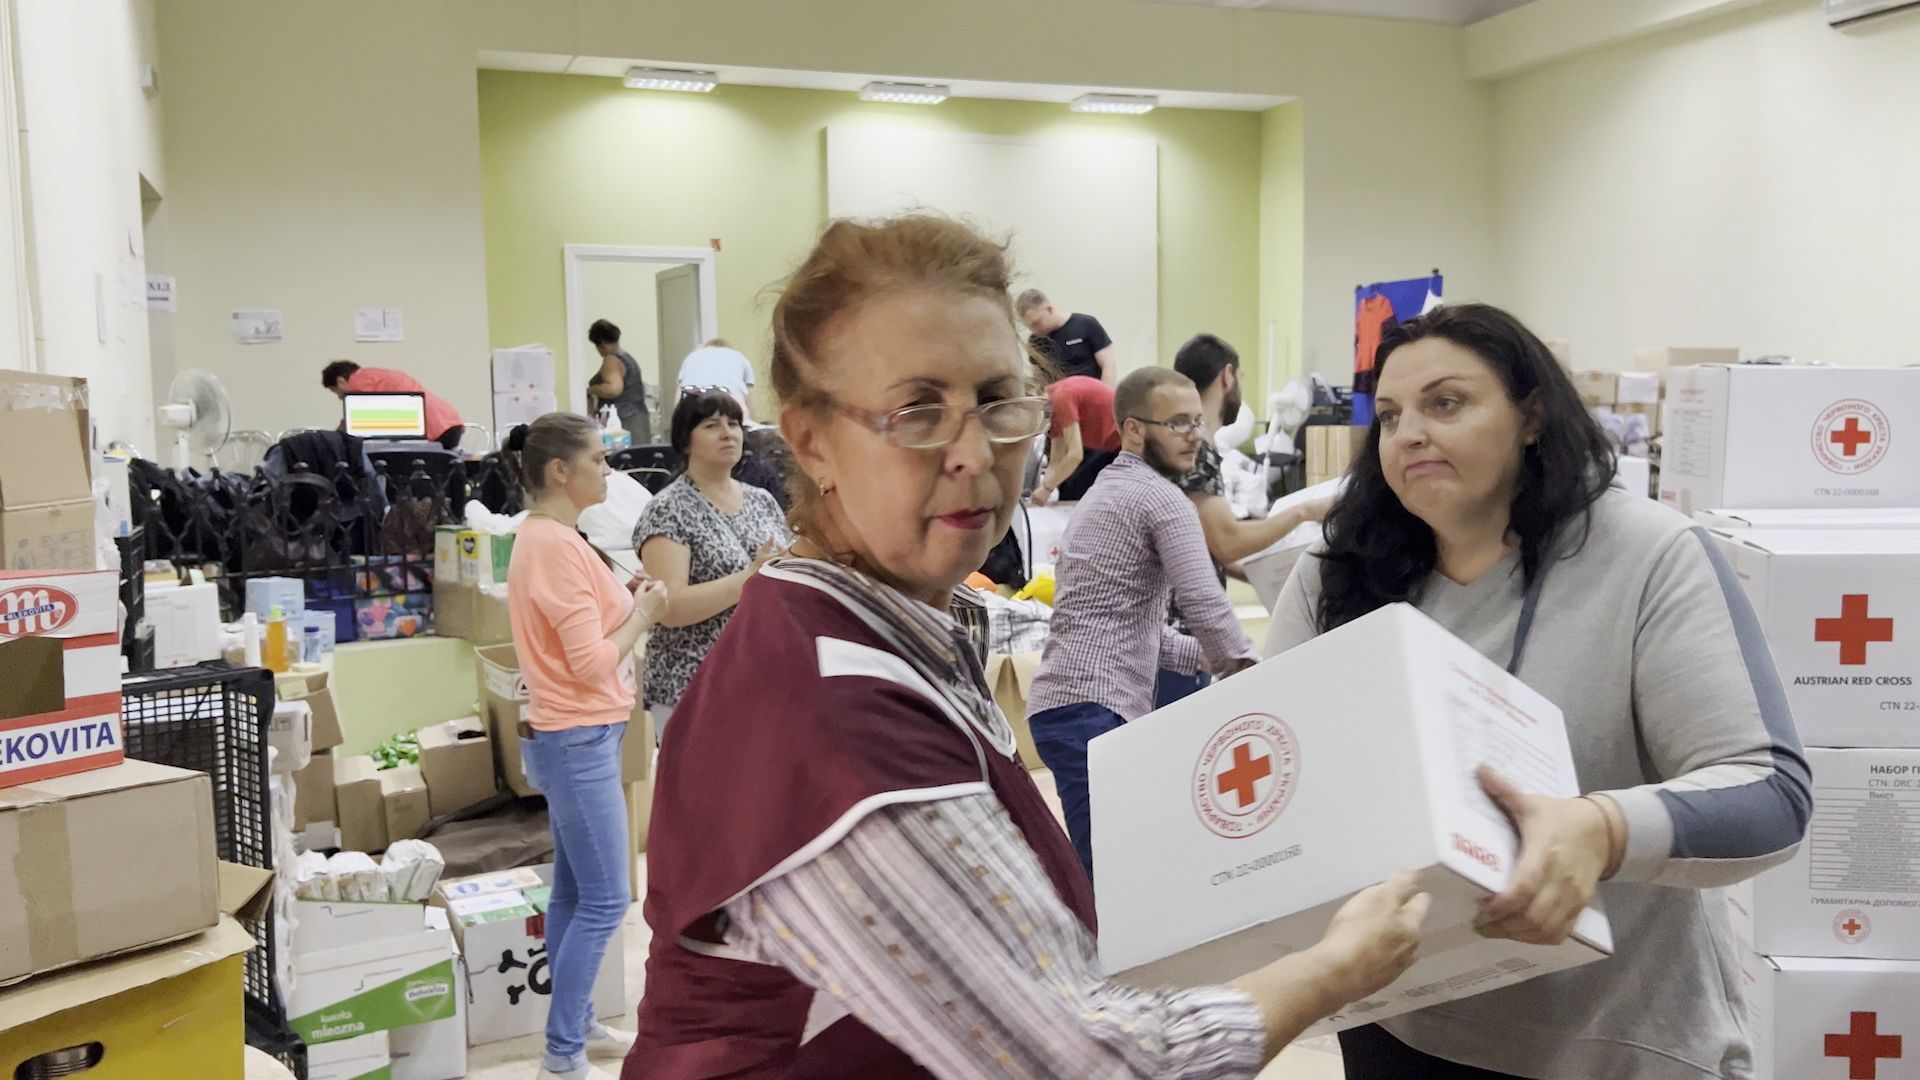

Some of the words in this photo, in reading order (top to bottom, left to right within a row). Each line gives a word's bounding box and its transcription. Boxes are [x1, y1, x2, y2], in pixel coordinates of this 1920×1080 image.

[1793, 676, 1848, 686] AUSTRIAN
[1851, 676, 1872, 686] RED
[1875, 676, 1912, 686] CROSS
[1880, 701, 1900, 711] CTN
[0, 721, 115, 765] KOVITA
[1870, 765, 1909, 775] НАБОР
